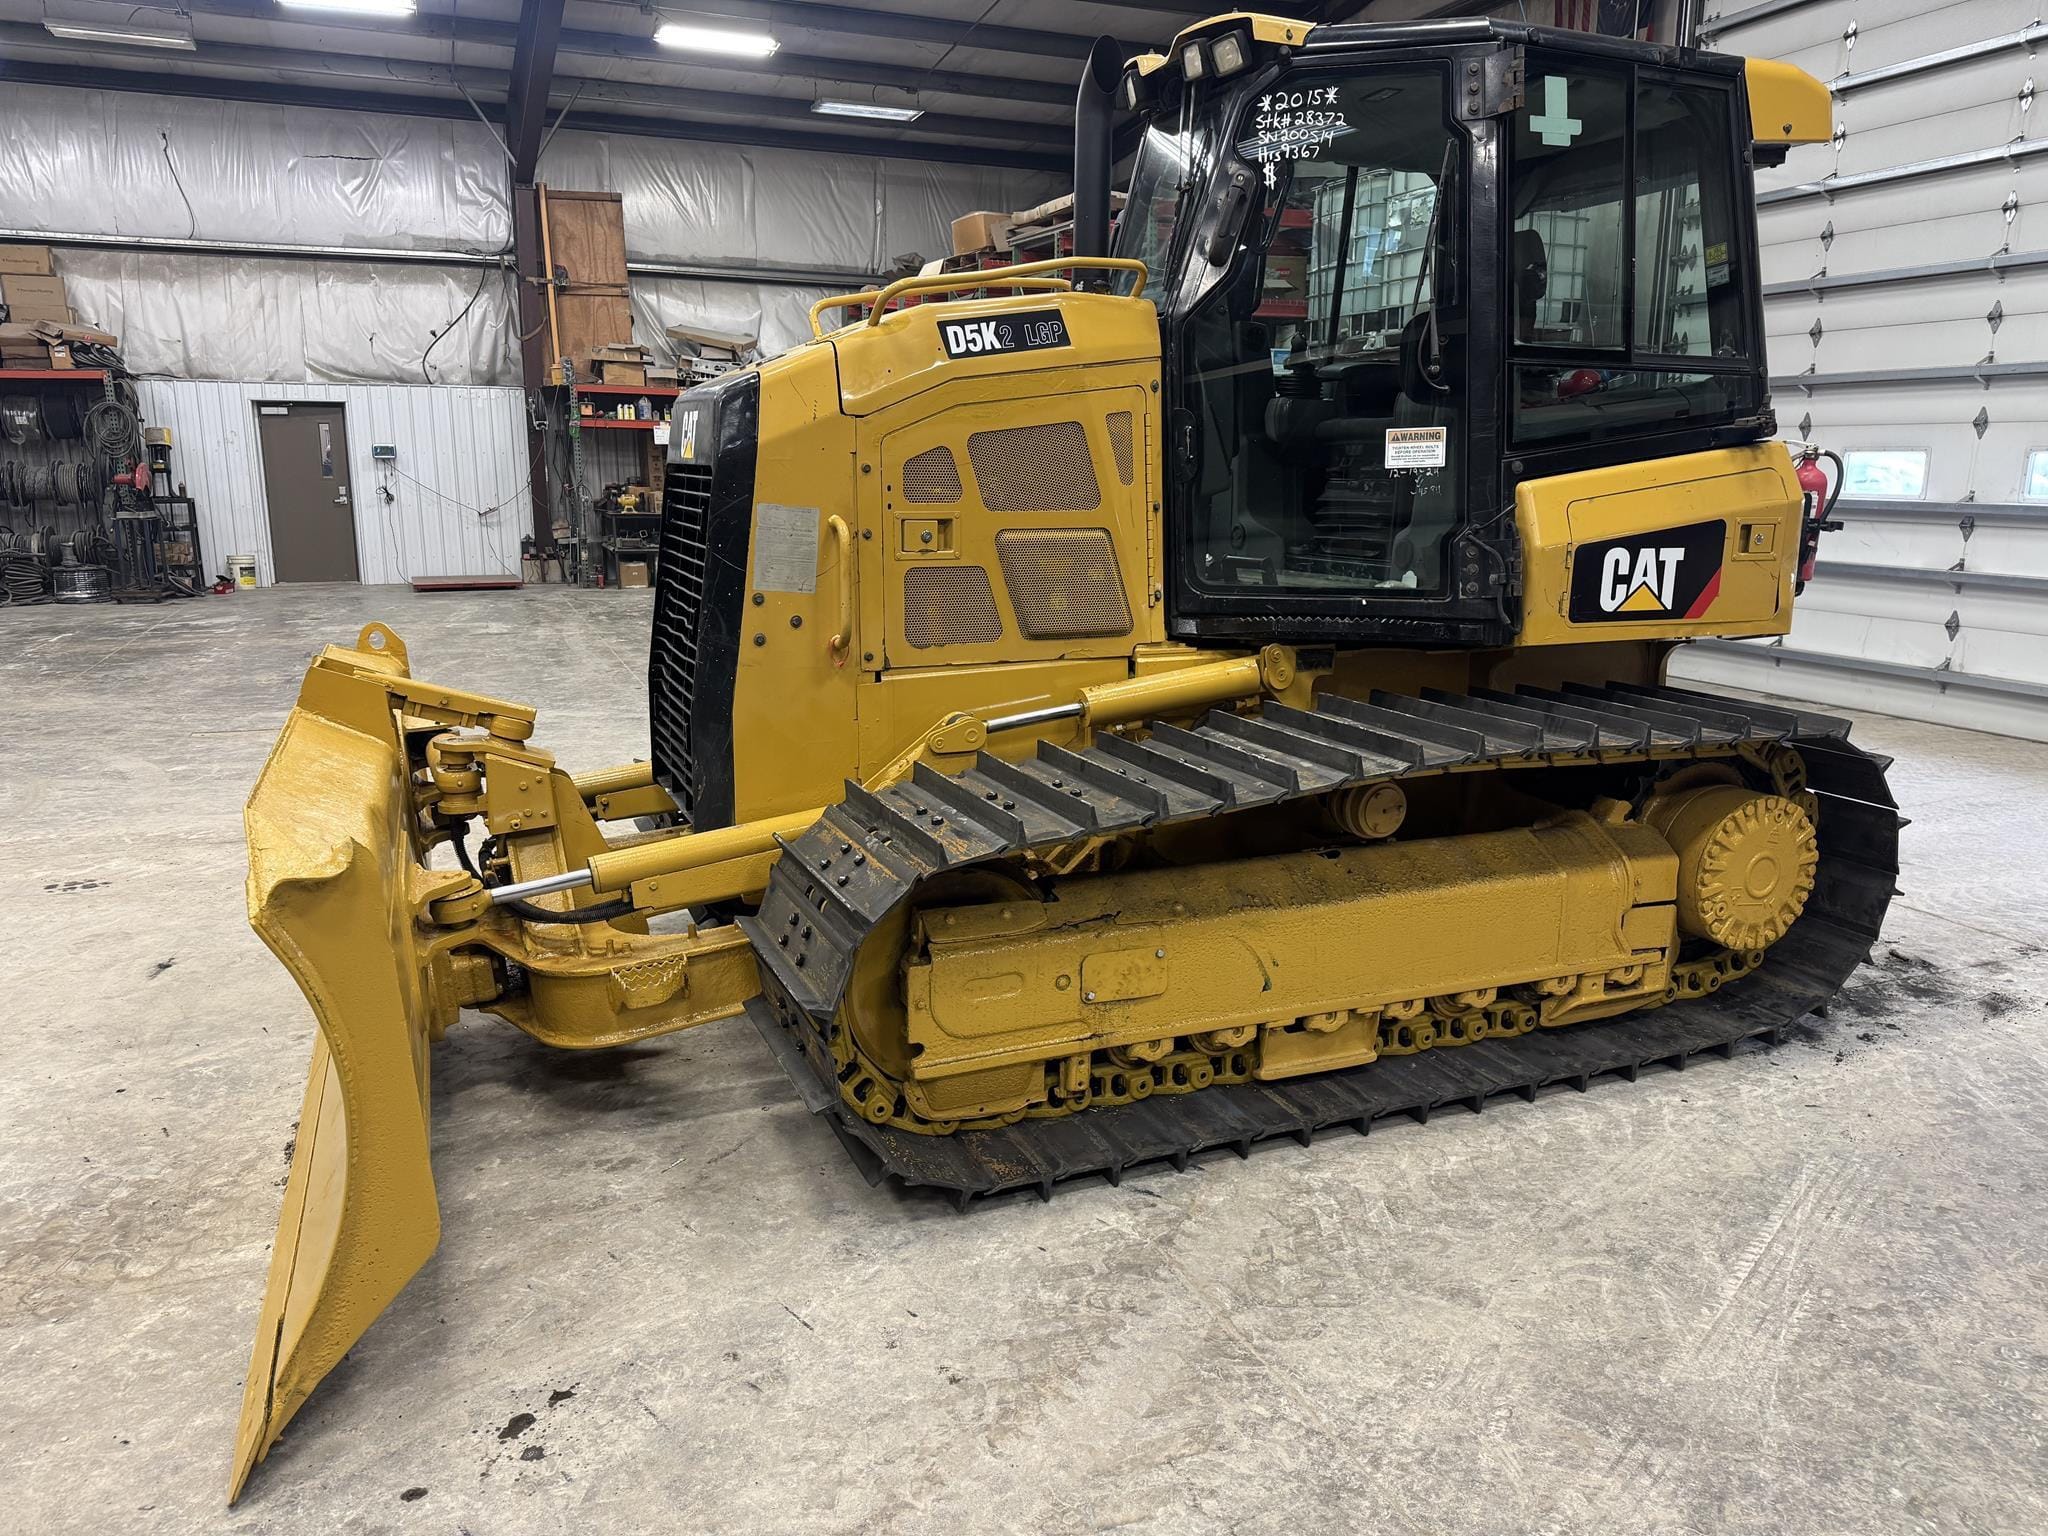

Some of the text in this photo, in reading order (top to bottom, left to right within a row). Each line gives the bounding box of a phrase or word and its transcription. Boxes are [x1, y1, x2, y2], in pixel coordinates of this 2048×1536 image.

[1294, 110, 1347, 126] 28372
[1258, 129, 1334, 148] SN 200514
[1258, 143, 1320, 163] Hrs 9367
[1262, 162, 1277, 190] $
[946, 320, 1063, 354] D5K2 LGP
[681, 410, 698, 458] CAT
[1400, 432, 1441, 441] WARNING
[1599, 546, 1686, 613] CAT
